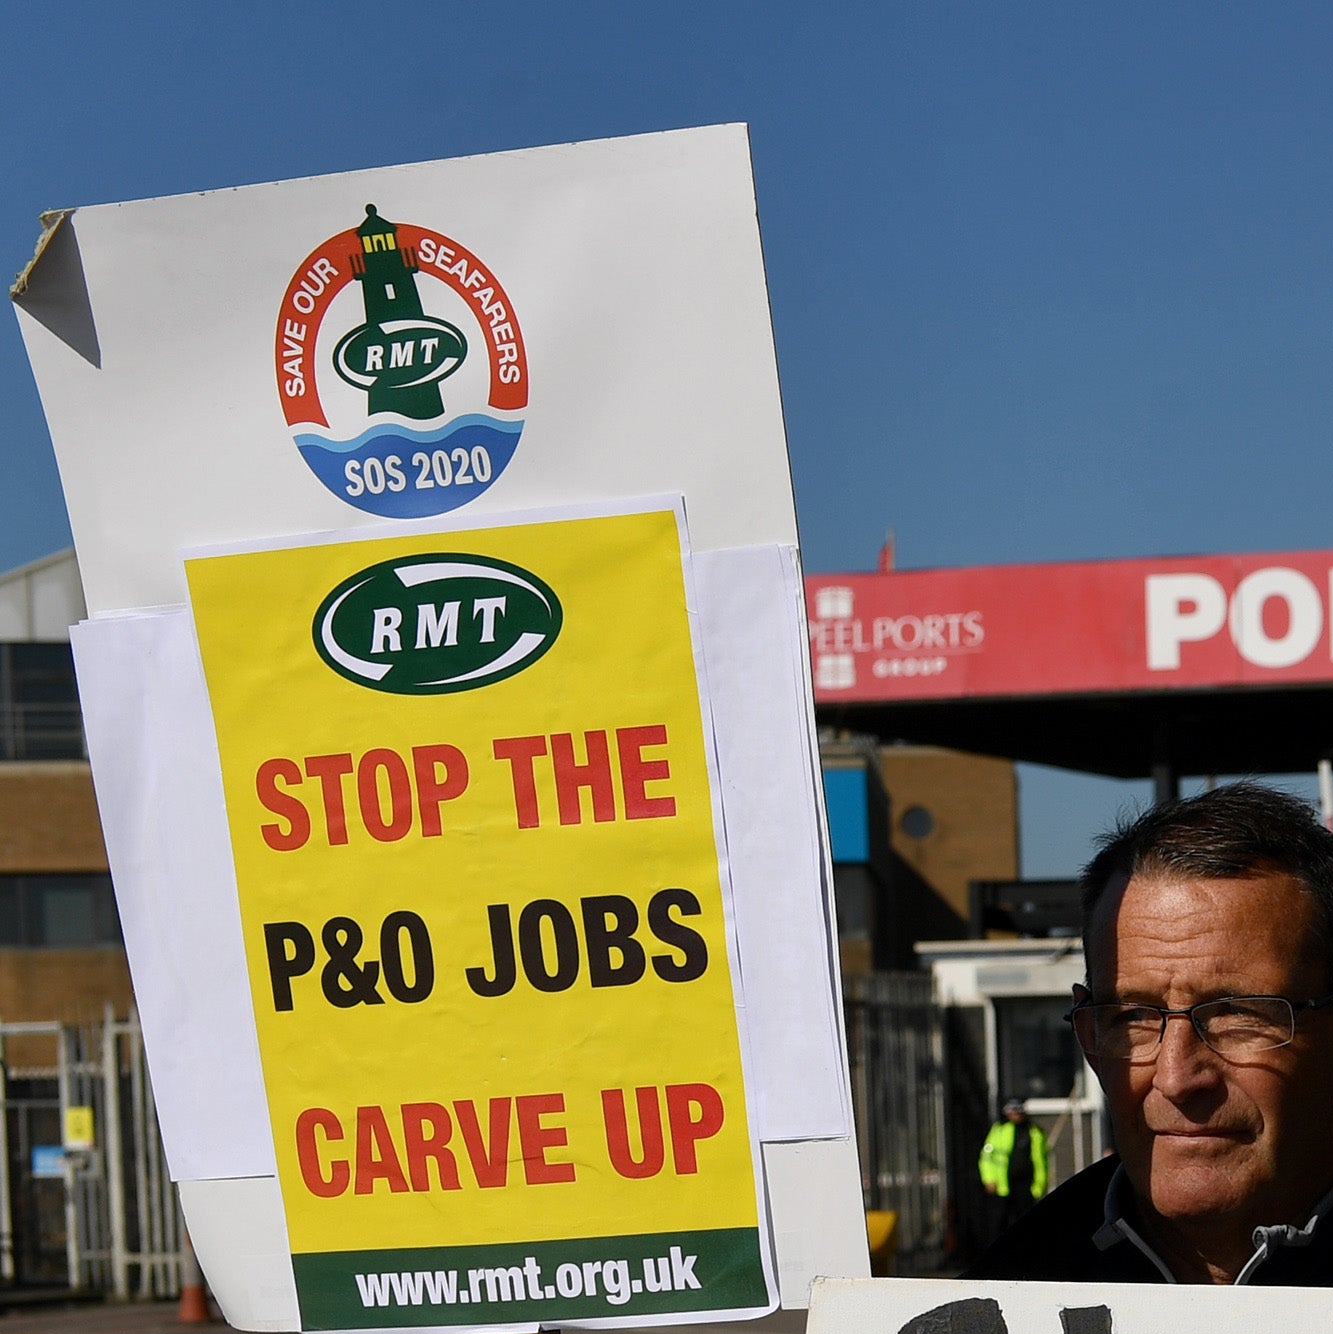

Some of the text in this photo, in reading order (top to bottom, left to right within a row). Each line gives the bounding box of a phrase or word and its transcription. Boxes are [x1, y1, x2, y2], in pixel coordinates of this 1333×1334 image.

[282, 237, 521, 397] SAVE OUR SEAFARERS
[364, 336, 440, 373] RMT
[343, 445, 493, 497] SOS 2020
[369, 595, 507, 655] RMT
[872, 610, 986, 652] PORTS
[254, 723, 677, 853] STOP THE
[262, 887, 710, 1013] P&O JOBS
[294, 1082, 726, 1199] CARVE UP
[354, 1245, 703, 1308] www.rmt.org.uk
